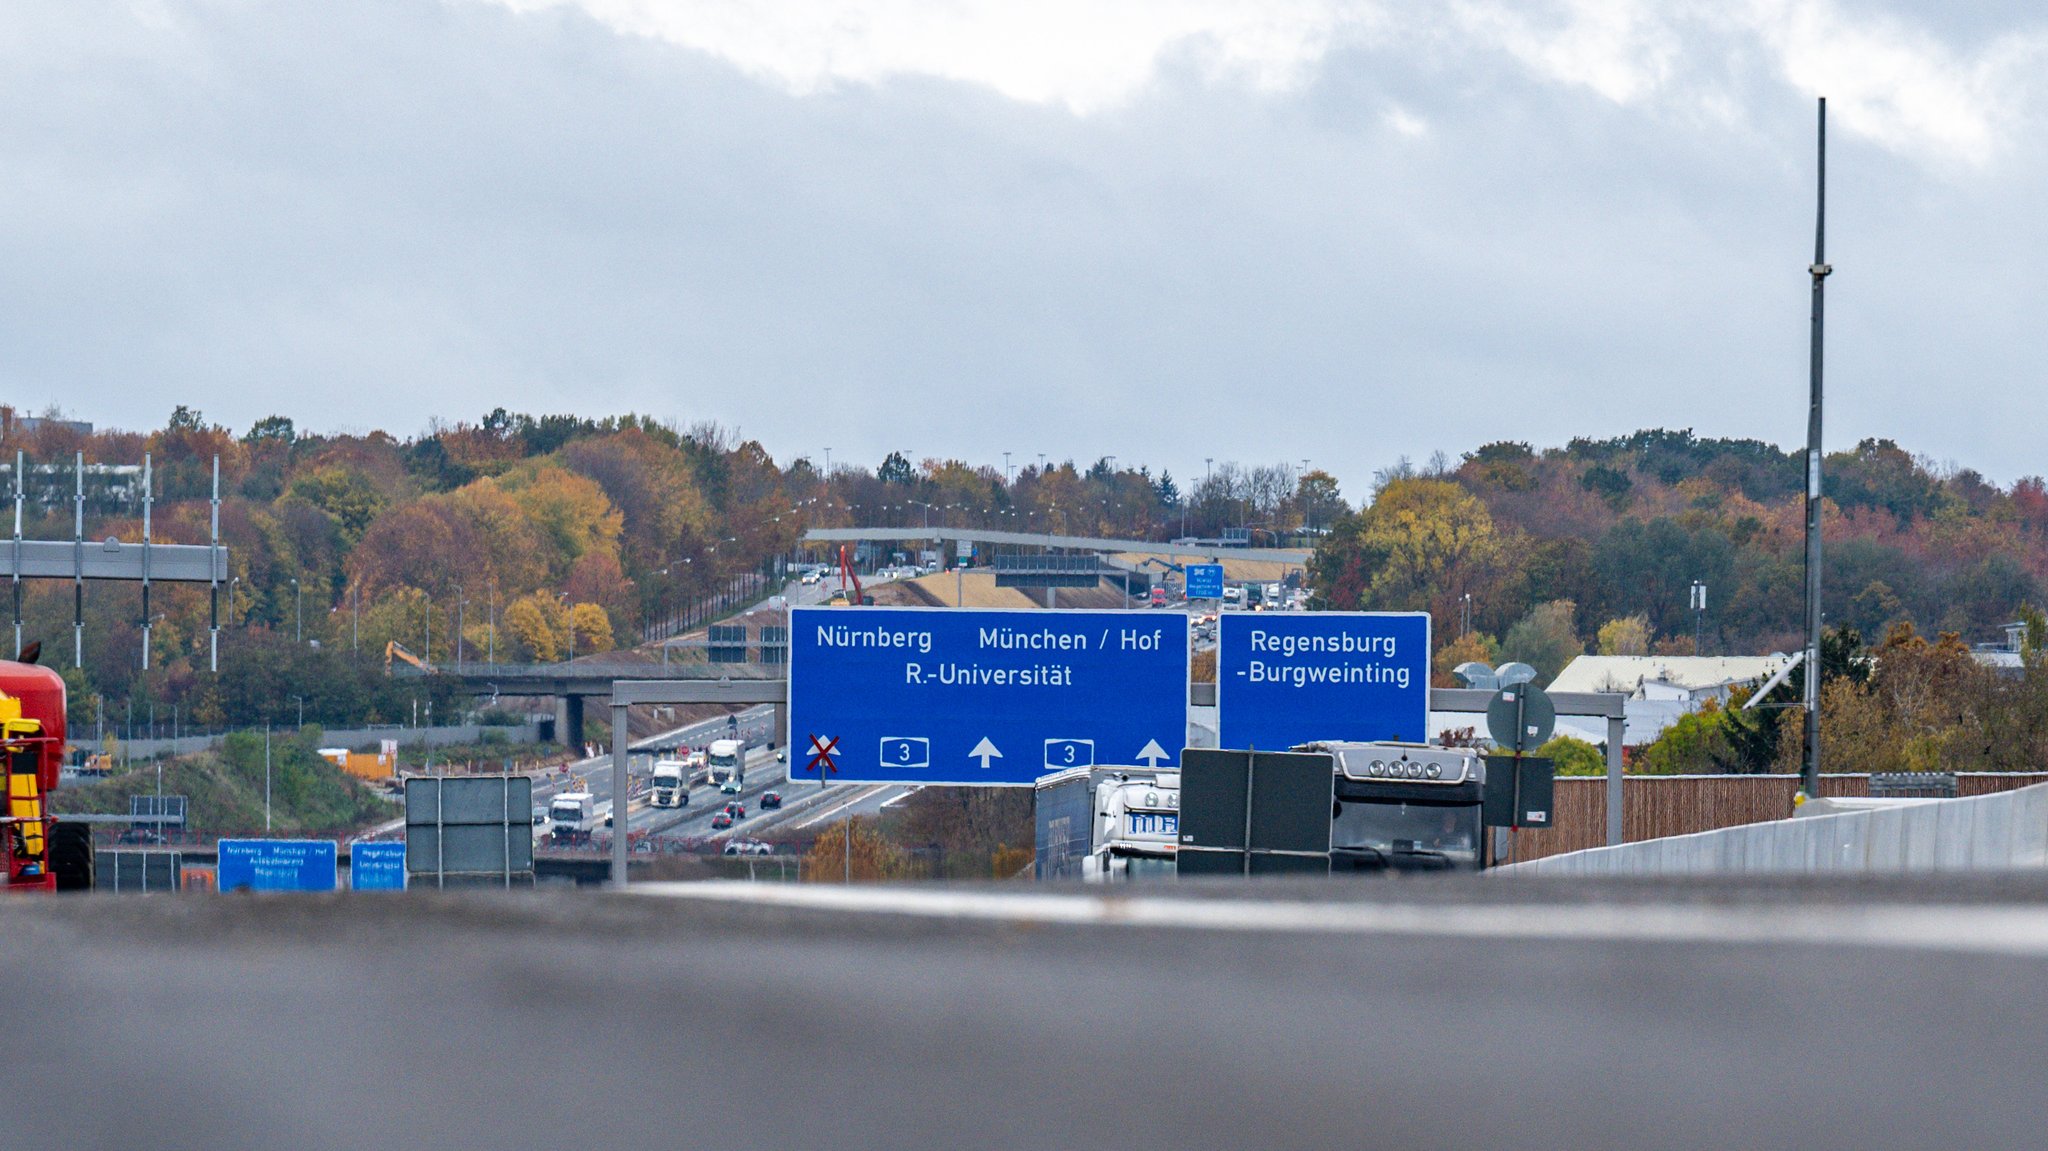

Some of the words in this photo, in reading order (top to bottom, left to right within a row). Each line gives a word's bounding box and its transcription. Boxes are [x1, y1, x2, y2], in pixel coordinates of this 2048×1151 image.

[817, 626, 932, 653] Nürnberg
[979, 626, 1087, 650] München
[1099, 629, 1109, 650] /
[1121, 629, 1162, 650] Hof
[1251, 631, 1397, 658] Regensburg
[906, 661, 1072, 686] R.-Universität
[1237, 661, 1410, 689] -Burgweinting
[899, 743, 910, 761] 3
[1065, 745, 1075, 763] 3
